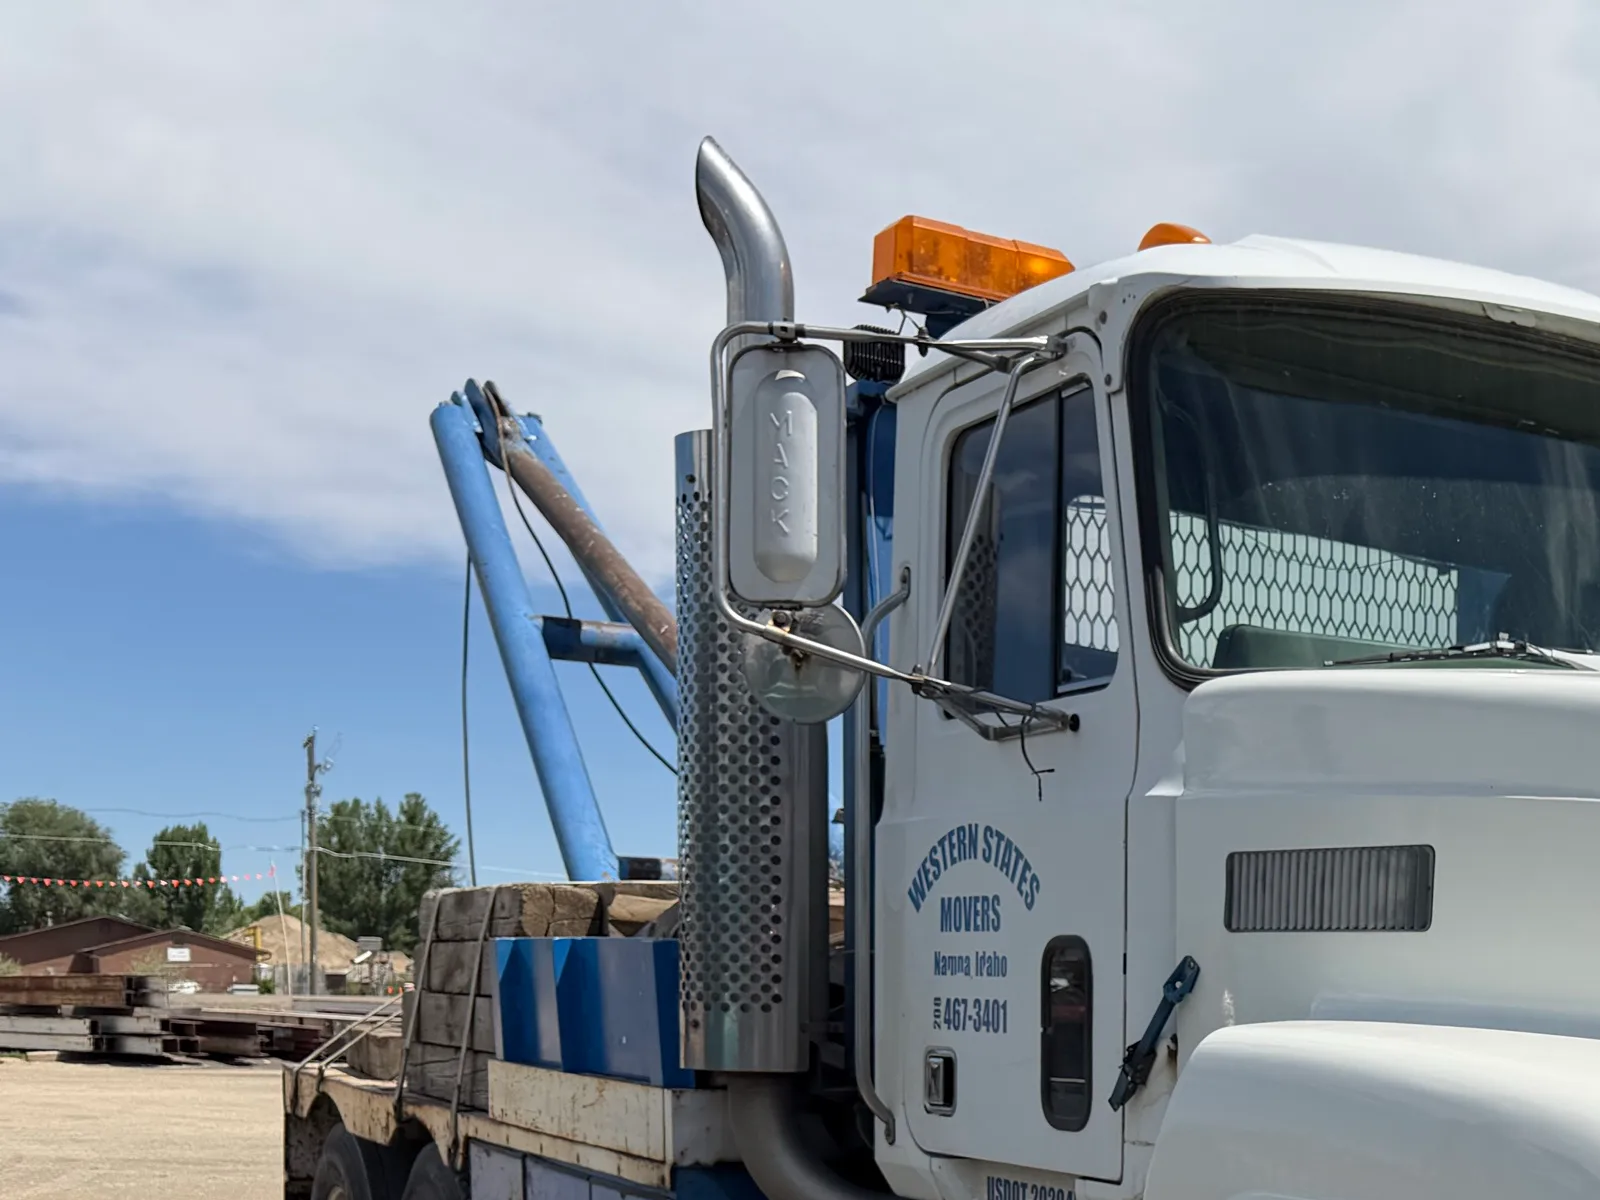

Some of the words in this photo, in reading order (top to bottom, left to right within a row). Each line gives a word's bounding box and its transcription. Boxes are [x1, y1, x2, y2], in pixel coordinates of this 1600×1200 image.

[769, 409, 793, 534] MACK
[907, 823, 979, 914] WESTERN
[982, 825, 1040, 911] STATES
[940, 894, 1001, 933] MOVERS
[975, 951, 1007, 978] Idaho
[943, 997, 1008, 1034] 467-3401
